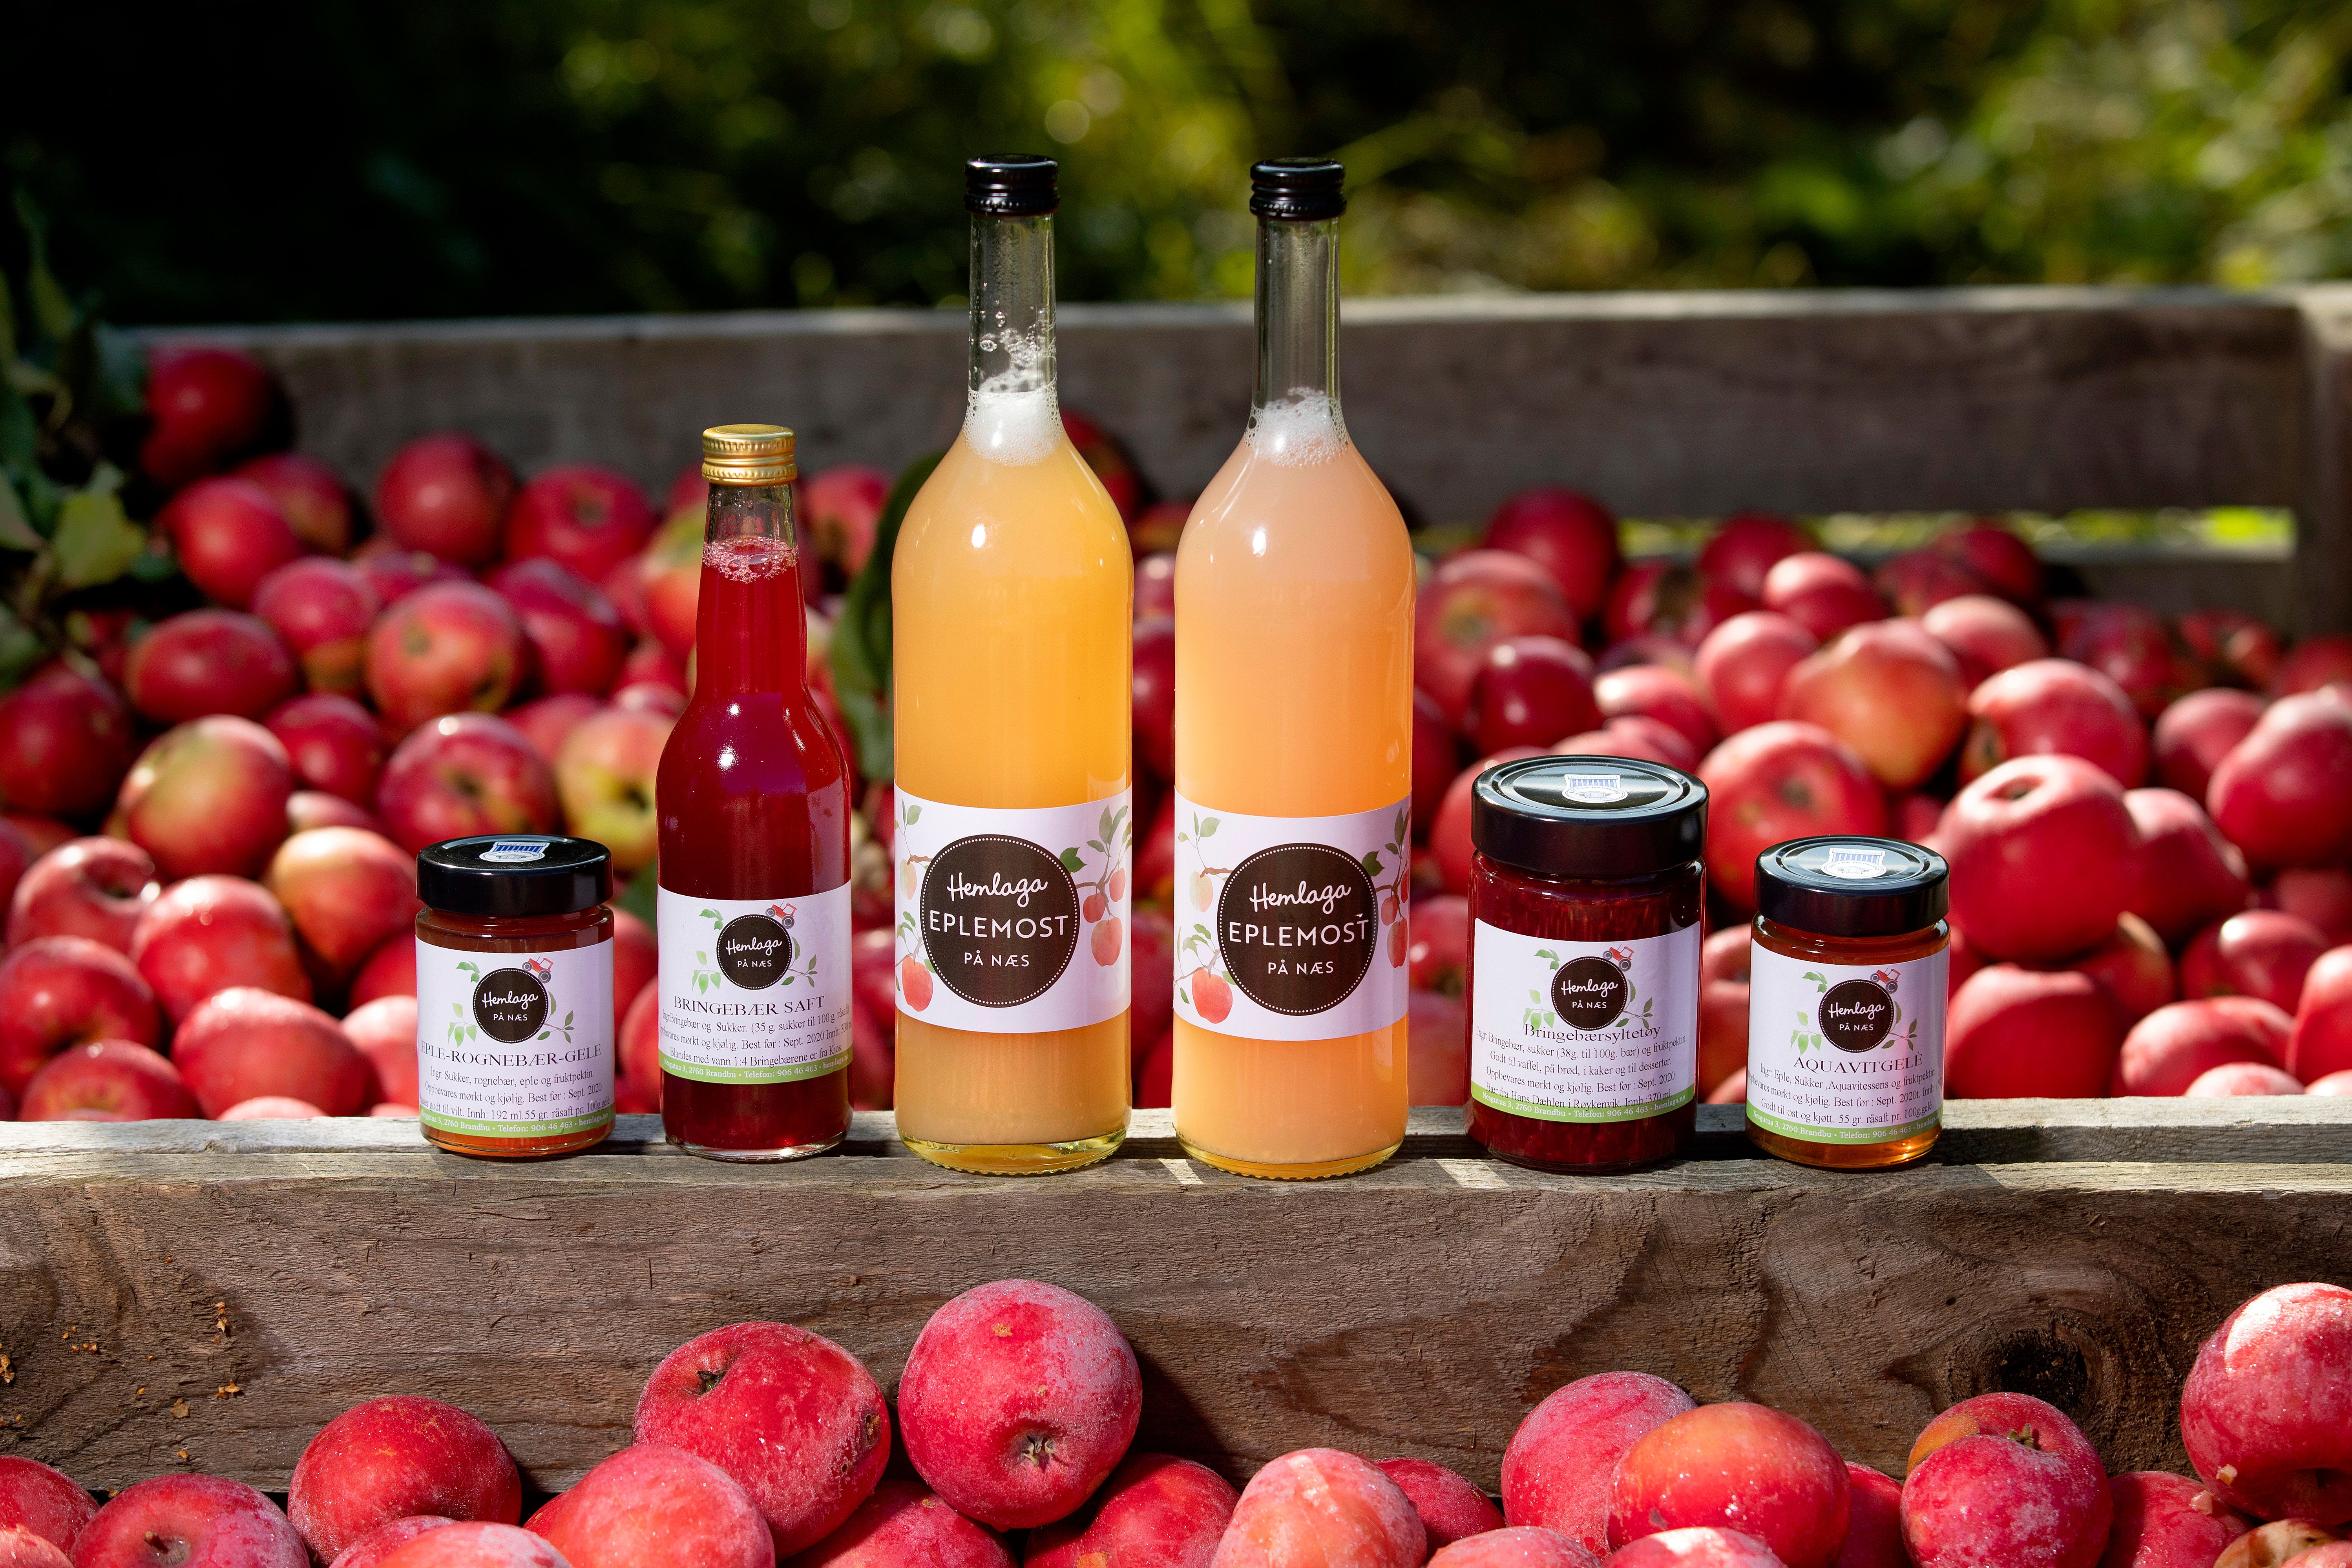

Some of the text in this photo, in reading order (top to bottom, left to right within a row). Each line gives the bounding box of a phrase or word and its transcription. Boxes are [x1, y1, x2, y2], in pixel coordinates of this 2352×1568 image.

[947, 872, 1048, 907] Hemlaga
[1250, 881, 1351, 914] Hemlaga
[929, 910, 1068, 939] EPLEMOST
[1229, 920, 1370, 947] EPLEMOST
[726, 937, 782, 956] Hemlaga
[964, 950, 1029, 967] PÅ NÆS
[1268, 960, 1334, 975] PÅ NÆS
[1561, 979, 1618, 997] Hemlaga
[482, 991, 539, 1009] Hemlaga
[674, 996, 824, 1015] BRINGEBÆR SAFT
[1572, 1000, 1583, 1008] PÅ
[1828, 1002, 1885, 1020] Hemlaga
[494, 1012, 504, 1020] PÅ
[702, 1023, 711, 1033] og
[716, 1022, 747, 1032] Sukker.
[751, 1022, 765, 1034] (35
[769, 1024, 775, 1033] g.
[779, 1020, 805, 1031] sukker
[818, 1013, 829, 1024] 100
[681, 1027, 840, 1051] mørkt og kjølig. Best før Sept. 2020 Innh:
[1477, 1026, 1687, 1061] Ingr: Bringebær, sukker (38g. til 100g. bær) og fruktpektin.
[1523, 1023, 1661, 1044] Bringebærsyltetøy
[421, 1040, 601, 1066] EPLE-ROGNEBÆR-GELE
[670, 1046, 691, 1061] Blandes
[694, 1055, 709, 1064] med
[735, 1057, 747, 1066] 1:4
[751, 1055, 808, 1068] Bringebærene
[1490, 1050, 1506, 1064] Godt
[1518, 1060, 1541, 1073] vaffel,
[1545, 1064, 1554, 1075] på
[1558, 1064, 1580, 1076] brød,
[1589, 1066, 1613, 1075] kaker
[1615, 1067, 1625, 1076] og
[1639, 1058, 1671, 1071] desserter.
[431, 1066, 593, 1088] Ingr: Sukker, rognebær, eple og fruktpektin.
[683, 1065, 687, 1073] 3,
[706, 1069, 736, 1078] Brandbu
[1486, 1066, 1675, 1095] Oppbevares mørkt og kjølig. Best før Sept. 2020
[1760, 1063, 1772, 1077] Ingr:
[1774, 1069, 1791, 1084] Eple,
[1795, 1075, 1823, 1088] Sukker
[1892, 1081, 1901, 1089] og
[425, 1081, 602, 1105] Oppbevares mørkt og kjølig. Best før Sept. 2020
[1483, 1092, 1506, 1106] Nesgutua
[1508, 1101, 1514, 1110] 3,
[1516, 1103, 1532, 1112] 2760
[1534, 1106, 1566, 1116] Brandbu
[1654, 1095, 1685, 1110] hemlaga.no
[1486, 1082, 1643, 1111] Bær fra Hans Dæhlen Røykenvik. Innh
[1771, 1088, 1790, 1099] mørkt
[1793, 1095, 1802, 1104] og
[1805, 1094, 1830, 1108] kjølig.
[1834, 1097, 1853, 1106] Best
[1857, 1098, 1869, 1106] før
[1877, 1096, 1896, 1107] Sept.
[1923, 1084, 1935, 1097] Innh:
[430, 1103, 440, 1112] godt
[451, 1106, 464, 1117] vilt.
[468, 1108, 488, 1119] Innh:
[491, 1110, 507, 1120] 192
[539, 1112, 548, 1121] gr.
[552, 1108, 573, 1118] råsaft
[575, 1108, 584, 1117] pr.
[1753, 1110, 1773, 1126] Nesgutua
[1775, 1121, 1780, 1129] 3,
[1782, 1124, 1798, 1133] 2760
[1801, 1127, 1831, 1137] Brandbu
[1761, 1098, 1775, 1112] Godt
[1801, 1113, 1811, 1122] og
[1813, 1112, 1835, 1124] kjøtt.
[1839, 1114, 1849, 1123] 55
[1853, 1117, 1863, 1126] gr.
[1866, 1112, 1888, 1123] råsaft
[1892, 1115, 1901, 1124] pr.
[438, 1117, 443, 1126] 3,
[460, 1122, 490, 1131] Brandbu
